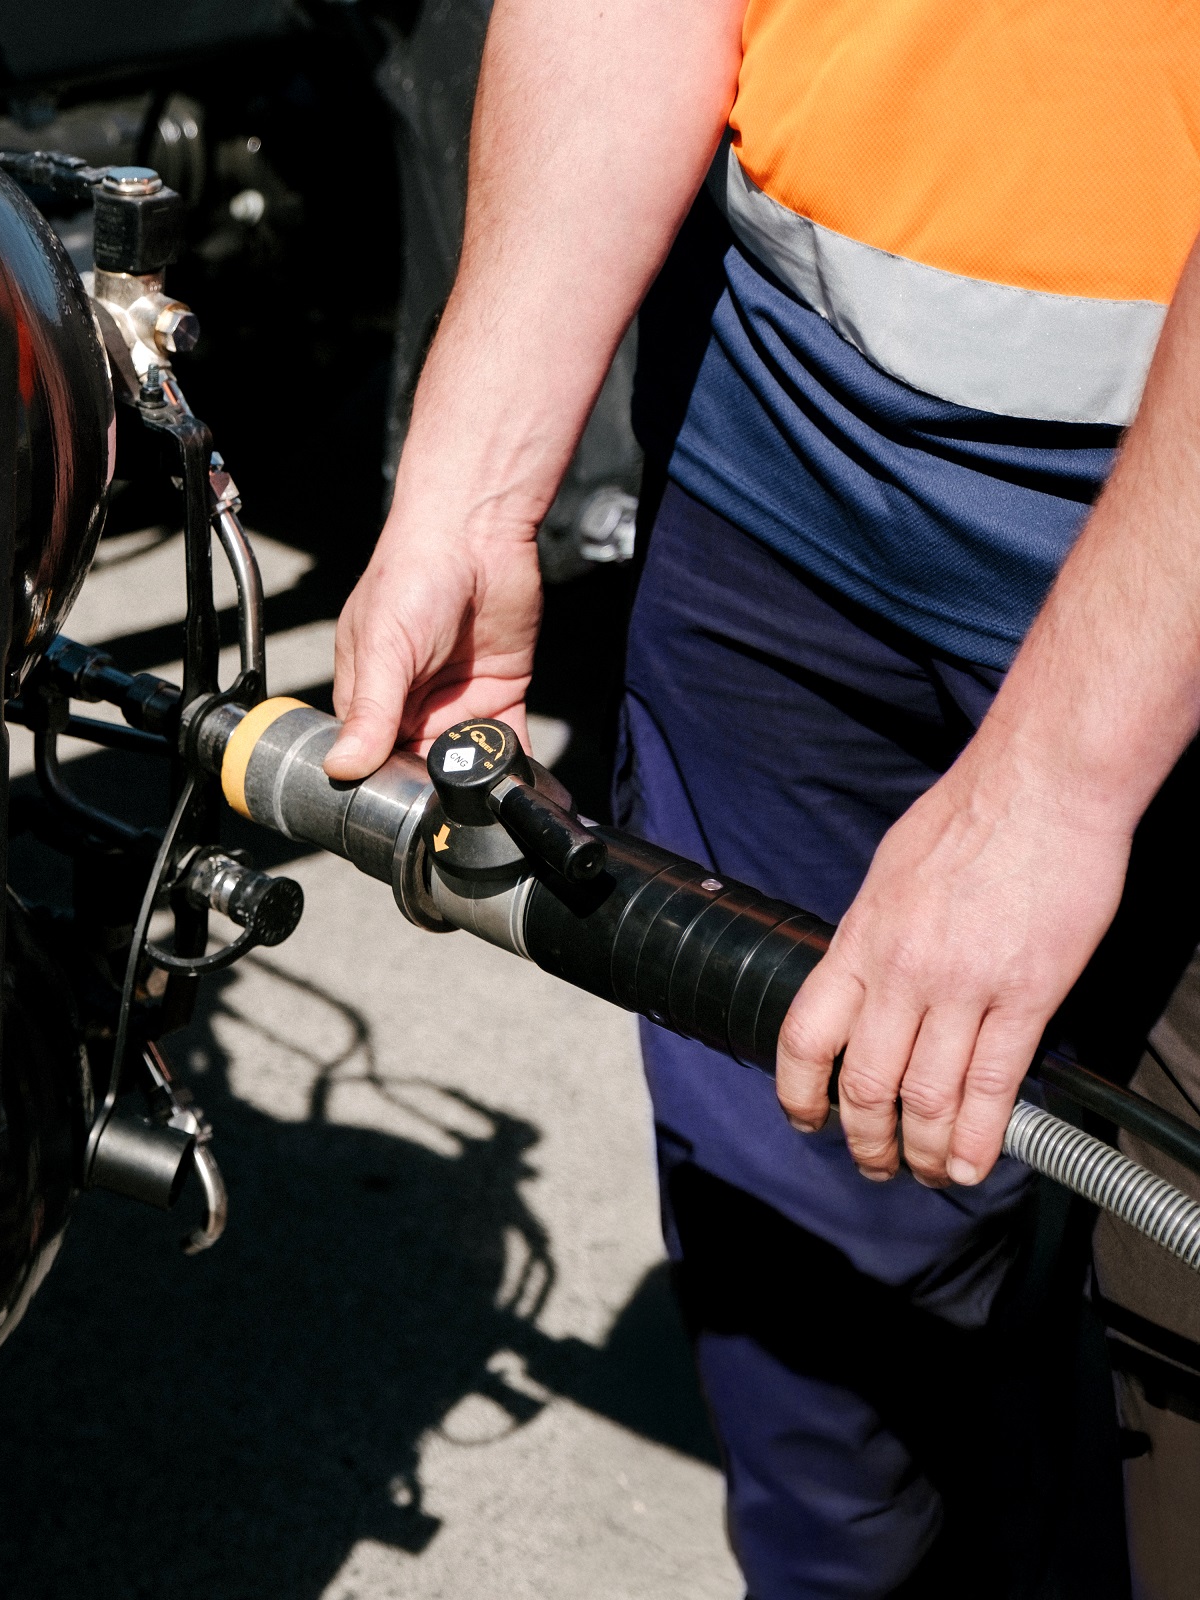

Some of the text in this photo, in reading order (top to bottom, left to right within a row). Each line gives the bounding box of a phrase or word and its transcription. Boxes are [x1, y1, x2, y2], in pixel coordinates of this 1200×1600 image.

[448, 731, 462, 741] off
[450, 752, 468, 767] CNG
[483, 761, 494, 770] on
